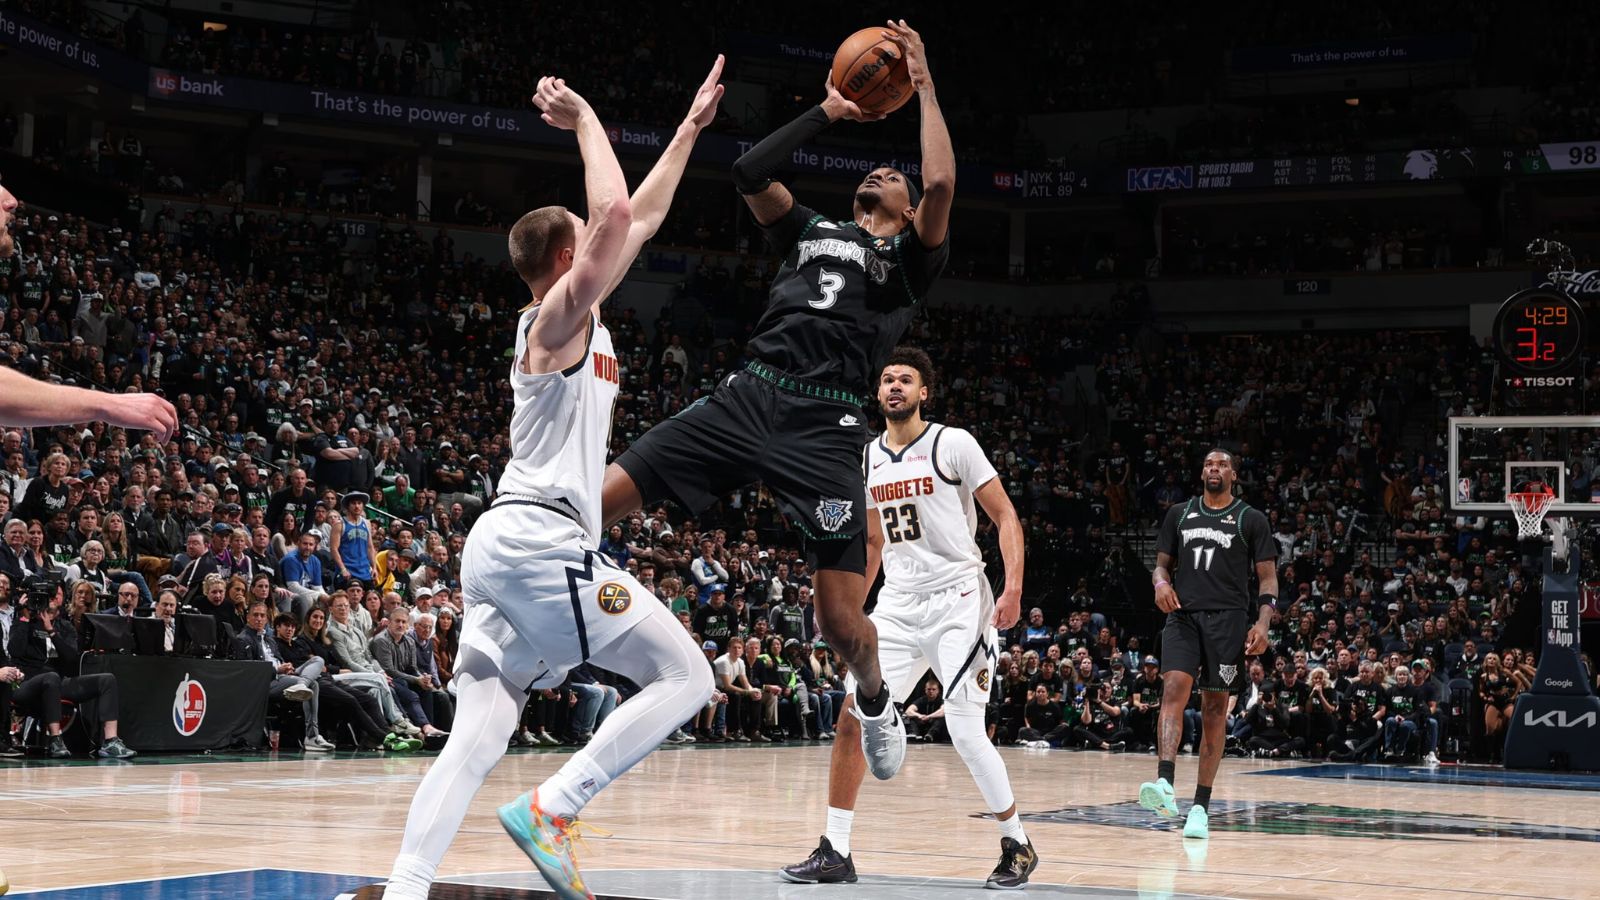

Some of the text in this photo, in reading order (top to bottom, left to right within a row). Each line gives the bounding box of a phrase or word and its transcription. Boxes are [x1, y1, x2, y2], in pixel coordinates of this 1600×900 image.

[19, 24, 63, 53] power
[65, 41, 80, 60] of
[82, 50, 101, 69] us.
[1290, 52, 1321, 63] That's
[1324, 50, 1341, 61] the
[1343, 49, 1376, 62] power
[1378, 47, 1390, 57] of
[155, 76, 224, 96] us bank
[311, 91, 520, 131] That's the power of us.
[621, 127, 661, 147] bank
[793, 148, 819, 167] the
[823, 154, 876, 172] power
[1569, 146, 1597, 165] 98
[1199, 161, 1254, 176] SPORTS RADIO
[1274, 168, 1291, 176] AST
[1532, 160, 1540, 170] 5
[995, 174, 1011, 187] us
[1029, 171, 1076, 184] NYK 140
[1080, 176, 1088, 190] 4
[1127, 165, 1193, 192] KFAN
[1198, 175, 1233, 189] FM 100.3
[1029, 185, 1073, 198] ATL 89
[796, 238, 898, 285] TIMBERWOLVES
[808, 266, 846, 310] 3
[1296, 281, 1318, 293] 120
[1525, 307, 1568, 325] 4:29
[1516, 327, 1556, 361] 3.2
[1523, 376, 1575, 387] TISSOT
[883, 504, 921, 544] 23
[1181, 527, 1236, 549] TIMBERWOLVES
[1192, 545, 1215, 571] 11
[1551, 600, 1568, 614] GET
[1551, 615, 1568, 629] THE
[1555, 630, 1573, 647] App
[1544, 678, 1573, 688] Google
